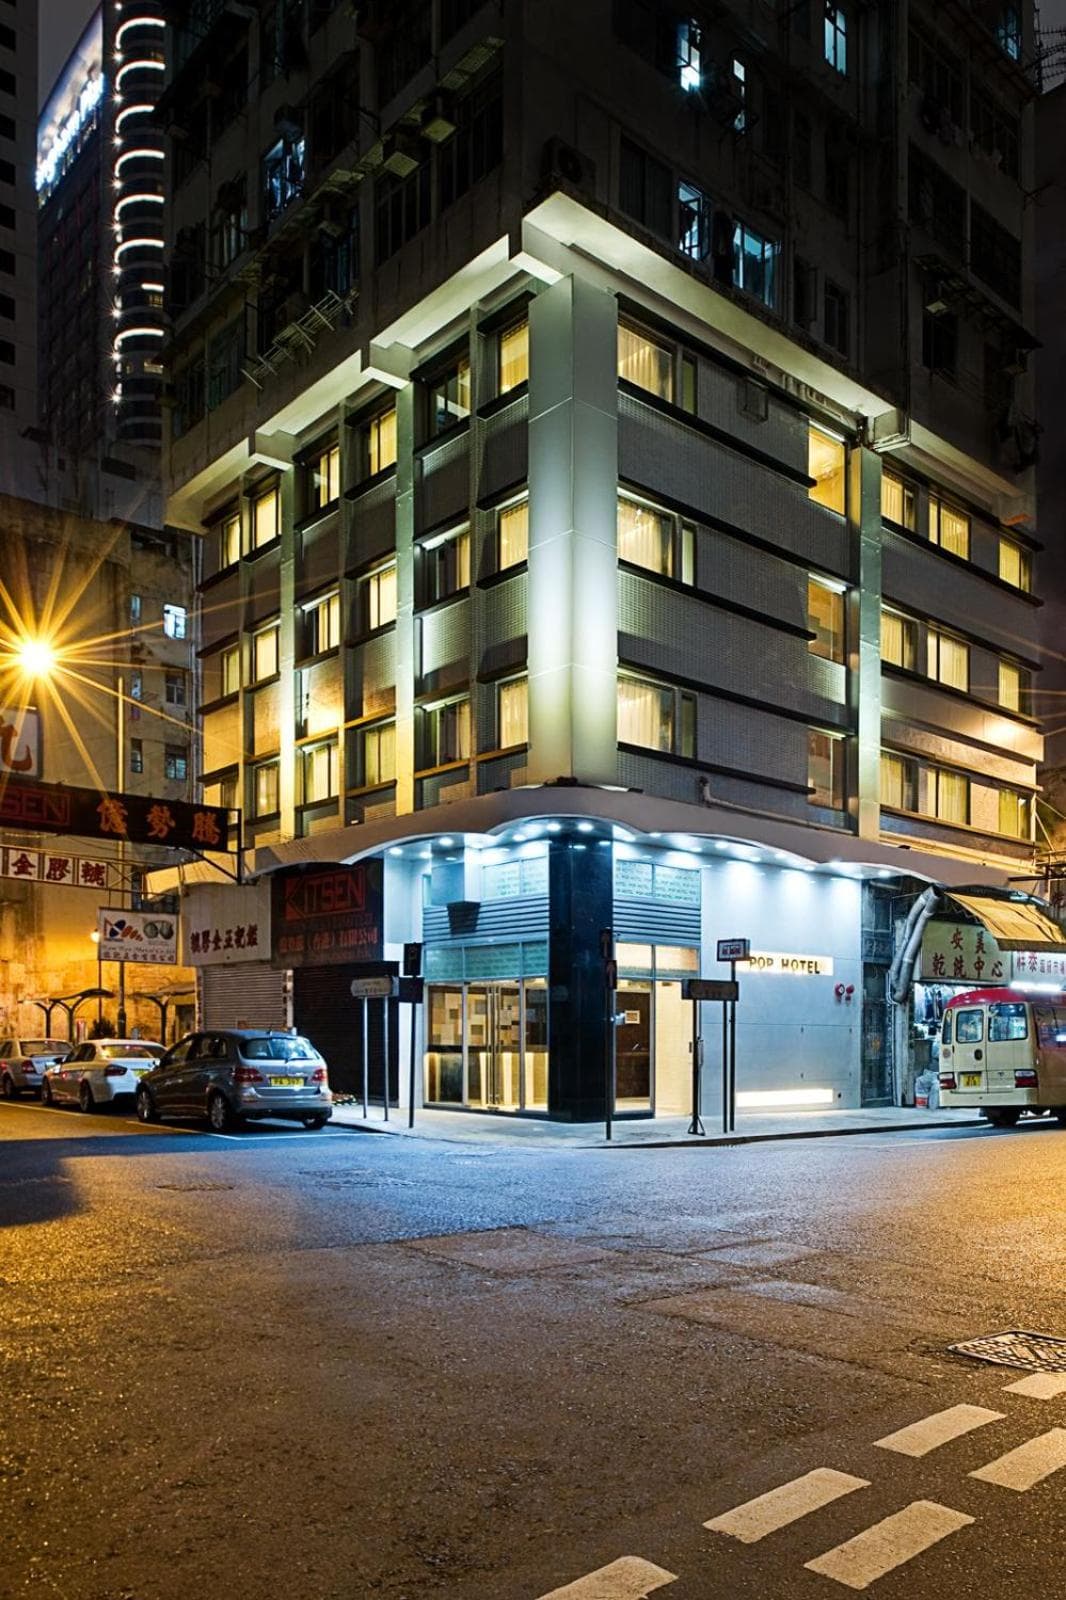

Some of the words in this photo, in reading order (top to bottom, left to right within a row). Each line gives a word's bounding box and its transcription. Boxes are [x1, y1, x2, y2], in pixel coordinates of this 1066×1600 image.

[749, 956, 774, 970] POP
[781, 958, 821, 975] HOTEL
[931, 952, 1004, 979] 乾洗中心
